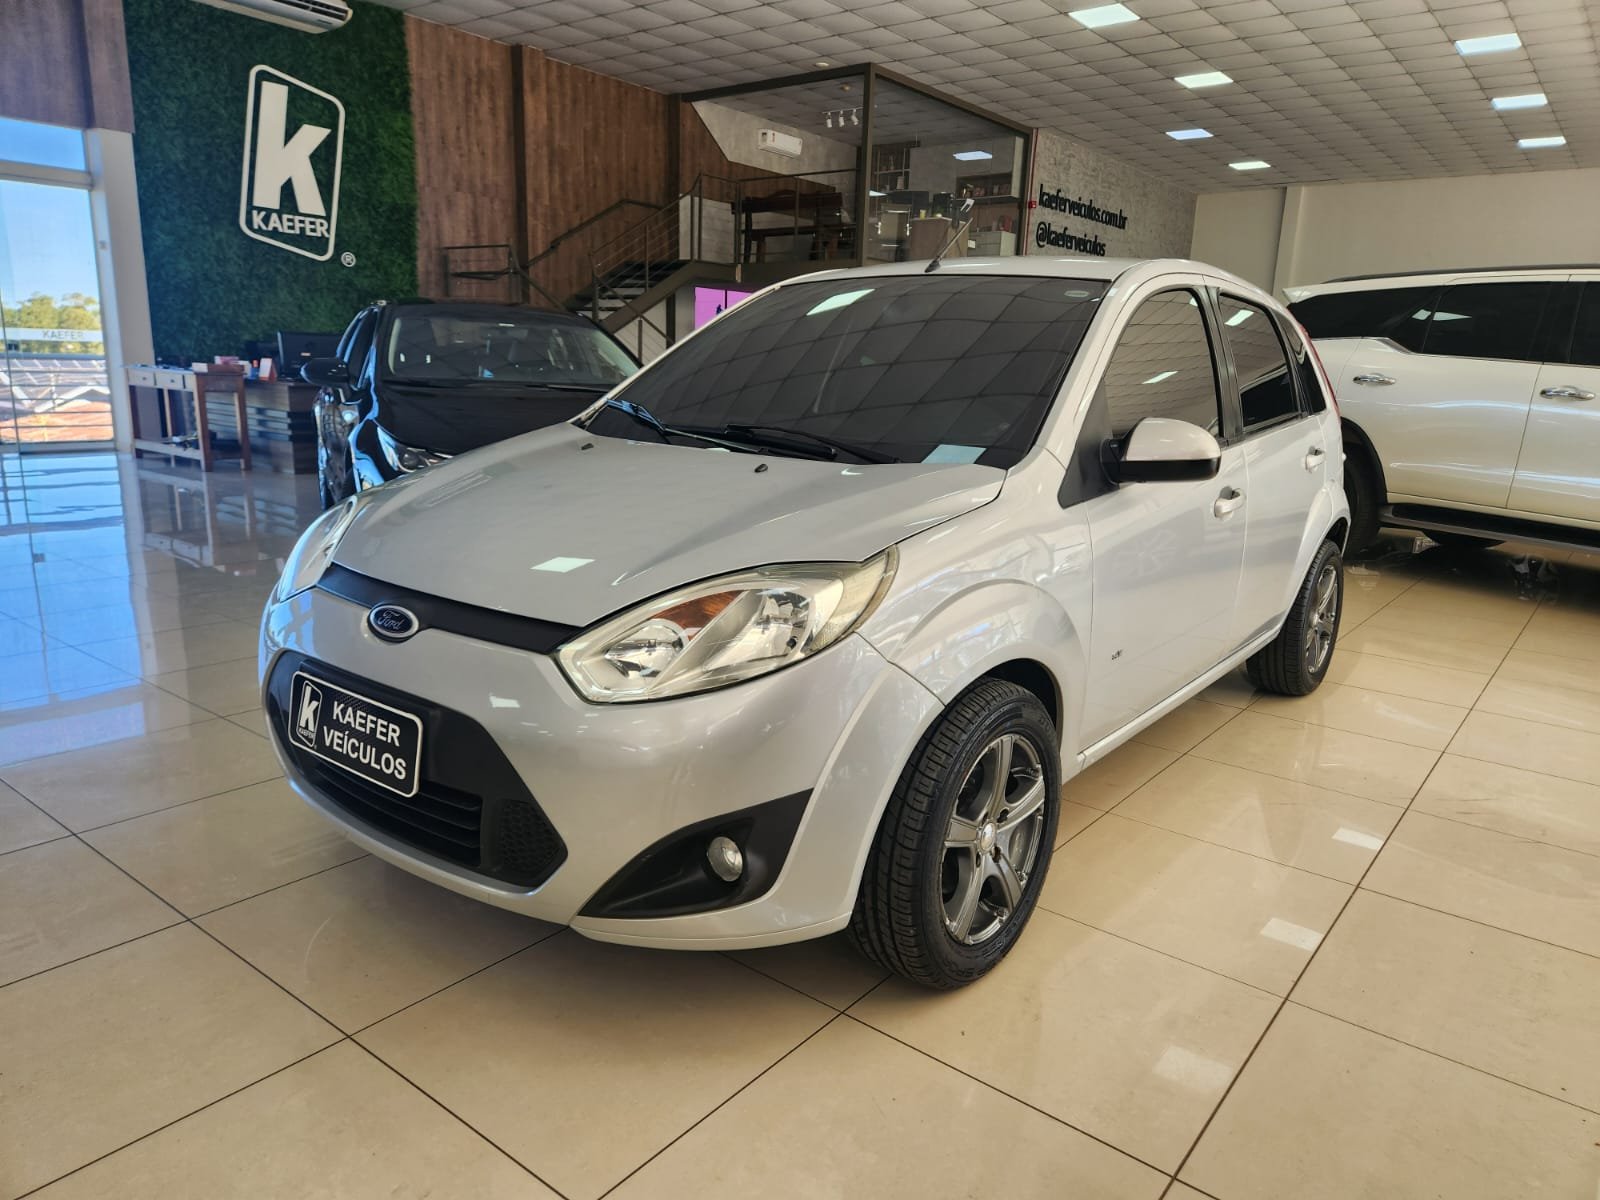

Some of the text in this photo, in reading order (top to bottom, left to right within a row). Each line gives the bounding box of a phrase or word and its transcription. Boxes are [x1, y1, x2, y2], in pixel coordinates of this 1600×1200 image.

[252, 210, 329, 238] KAEFER
[1038, 183, 1128, 230] kaeferveiculos.com.br
[1035, 221, 1106, 256] @kaeferveiculos
[42, 330, 84, 340] KAEFER
[377, 609, 404, 631] Ford
[333, 700, 401, 747] KAEFER
[323, 725, 407, 780] VEÍCULOS
